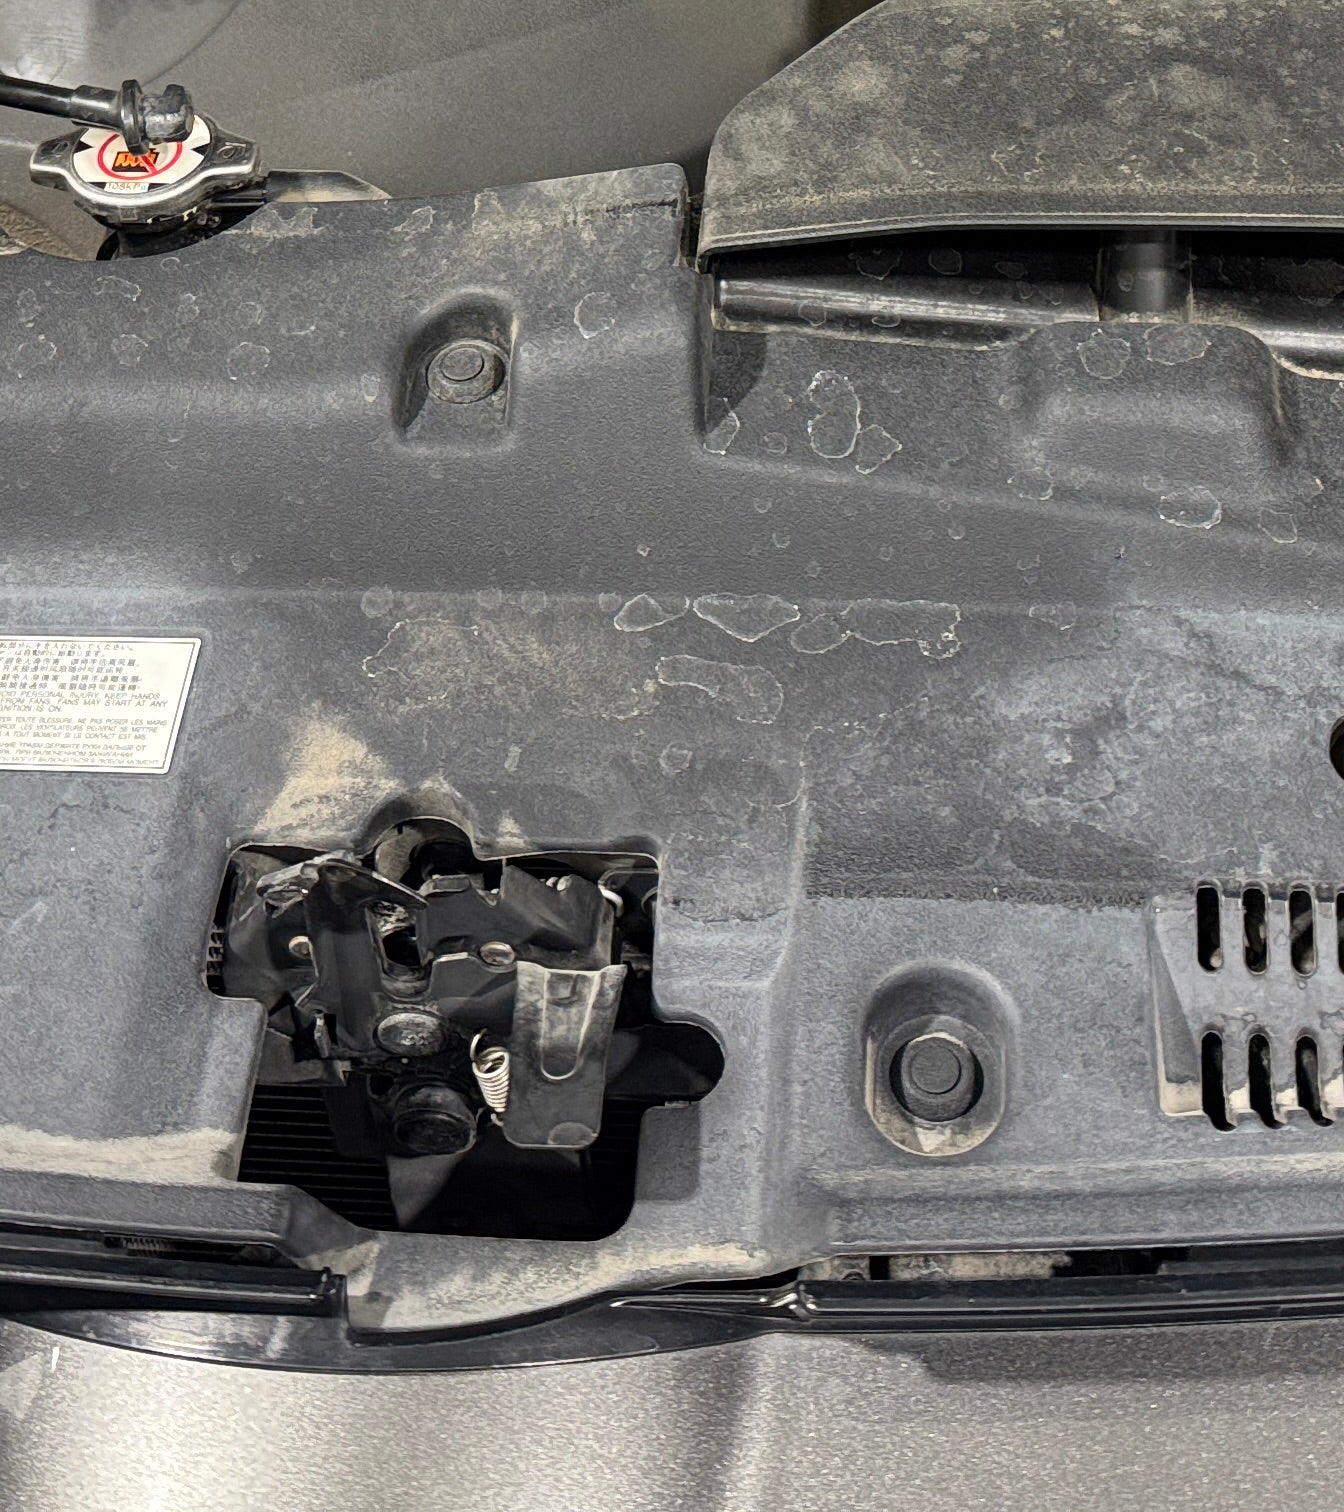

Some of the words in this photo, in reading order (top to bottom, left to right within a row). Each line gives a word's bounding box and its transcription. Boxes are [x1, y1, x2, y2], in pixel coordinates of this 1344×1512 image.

[20, 690, 63, 698] PERSONAL
[104, 699, 132, 707] START
[149, 700, 169, 708] ANY
